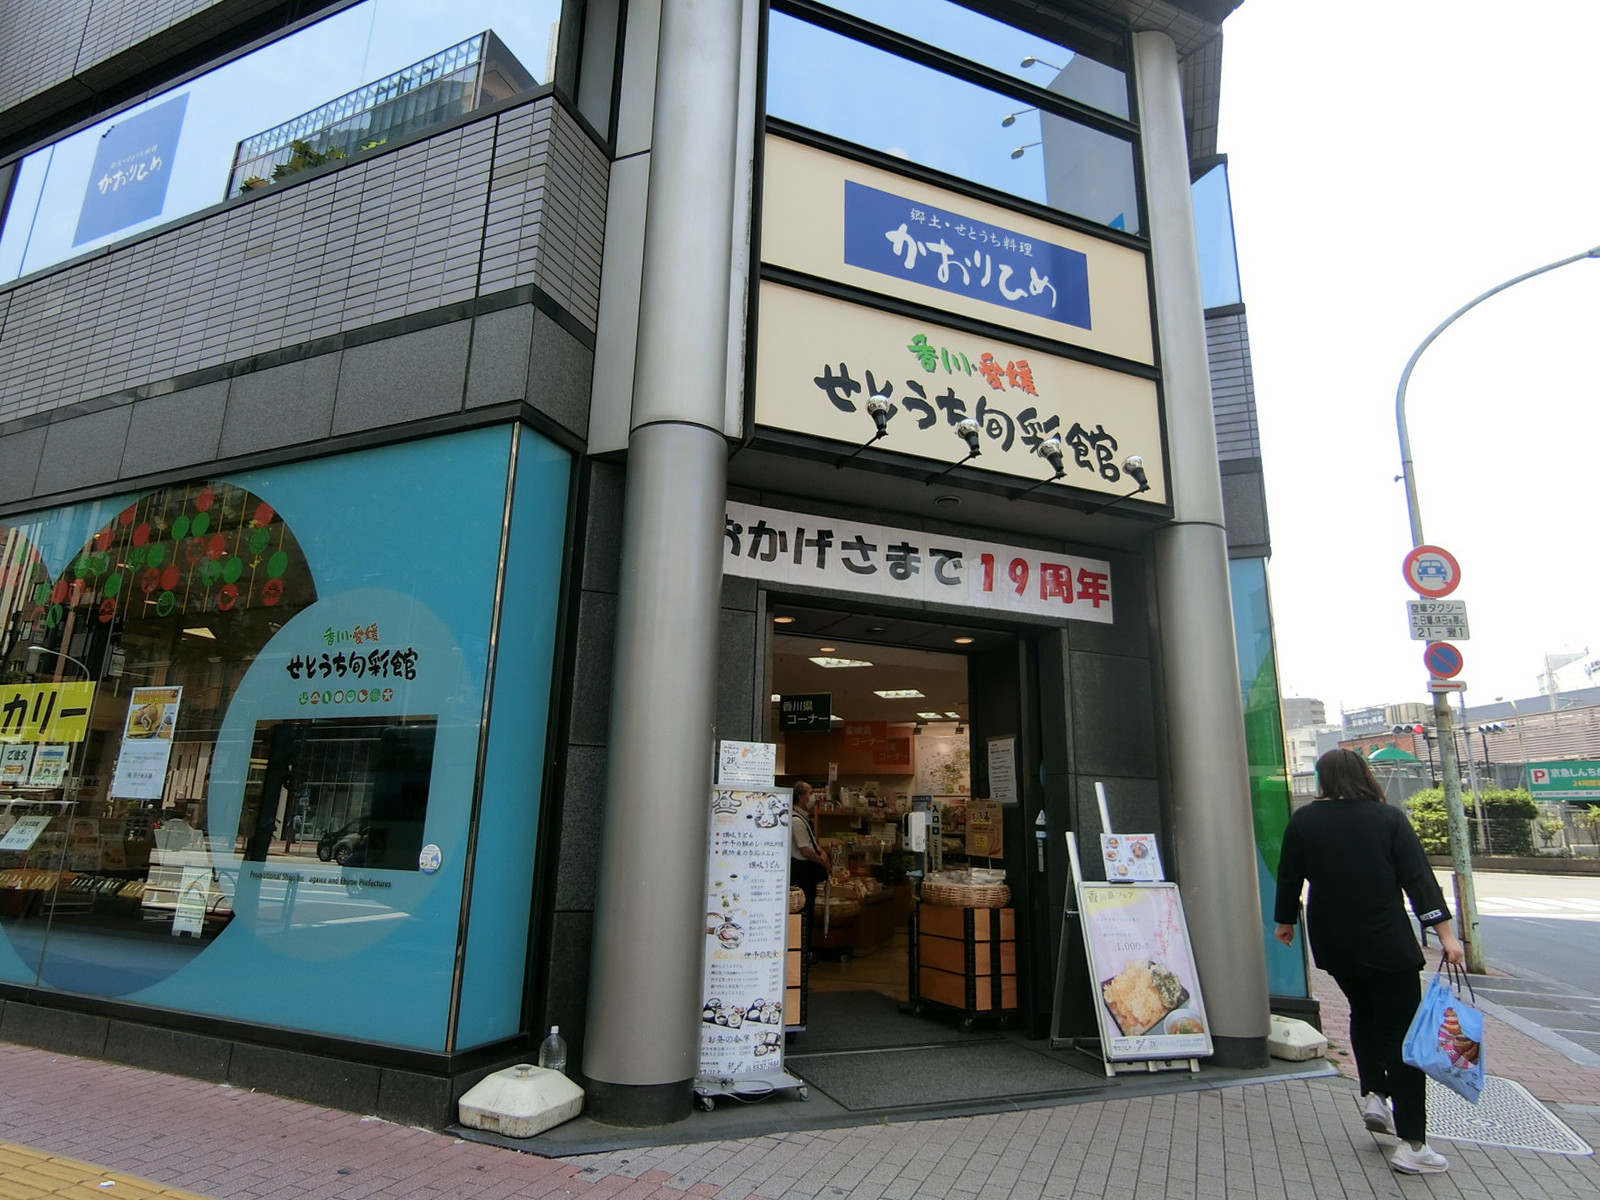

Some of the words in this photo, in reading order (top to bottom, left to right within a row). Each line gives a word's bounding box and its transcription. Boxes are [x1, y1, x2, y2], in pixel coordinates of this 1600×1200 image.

[98, 155, 163, 194] かおりひめ
[910, 208, 1033, 257] 郷土・せとうち料理
[885, 223, 1056, 308] かおりひめ
[907, 333, 1040, 397] 香川・愛媛
[814, 361, 1121, 483] せとうち旬彩館
[1411, 603, 1462, 613] 空車タクシー
[323, 622, 379, 646] 香川・愛媛
[286, 647, 418, 680] せとうち旬彩館
[1, 691, 87, 735] カリー
[782, 700, 814, 712] 香川県
[787, 713, 829, 725] コーナー
[851, 736, 886, 746] コーナー
[359, 878, 392, 888] Prefectures
